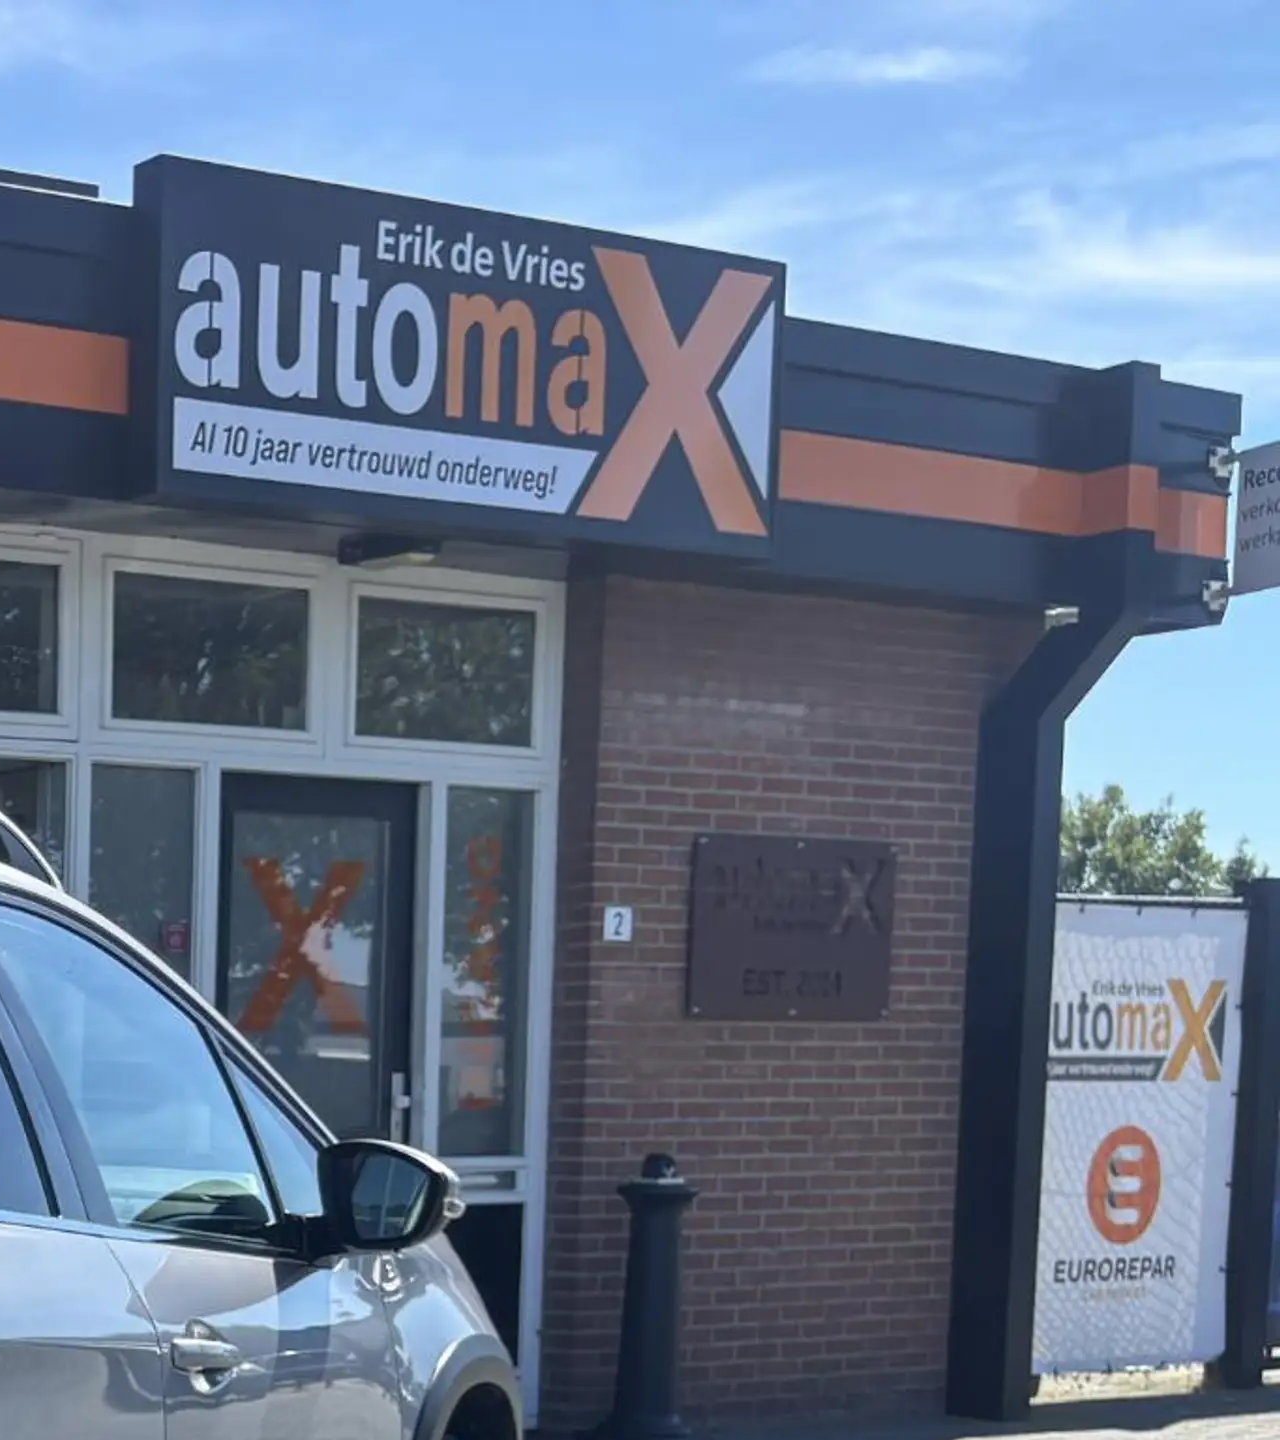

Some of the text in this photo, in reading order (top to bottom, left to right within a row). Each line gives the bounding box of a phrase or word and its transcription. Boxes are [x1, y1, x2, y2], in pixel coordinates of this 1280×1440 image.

[376, 218, 587, 292] Erik de Vries
[223, 424, 248, 458] 10
[250, 428, 302, 466] jaar
[307, 441, 433, 481] vertrouwd
[436, 456, 559, 499] onderweg!
[612, 911, 626, 937] 2
[1053, 1255, 1176, 1284] EUROREPAR
